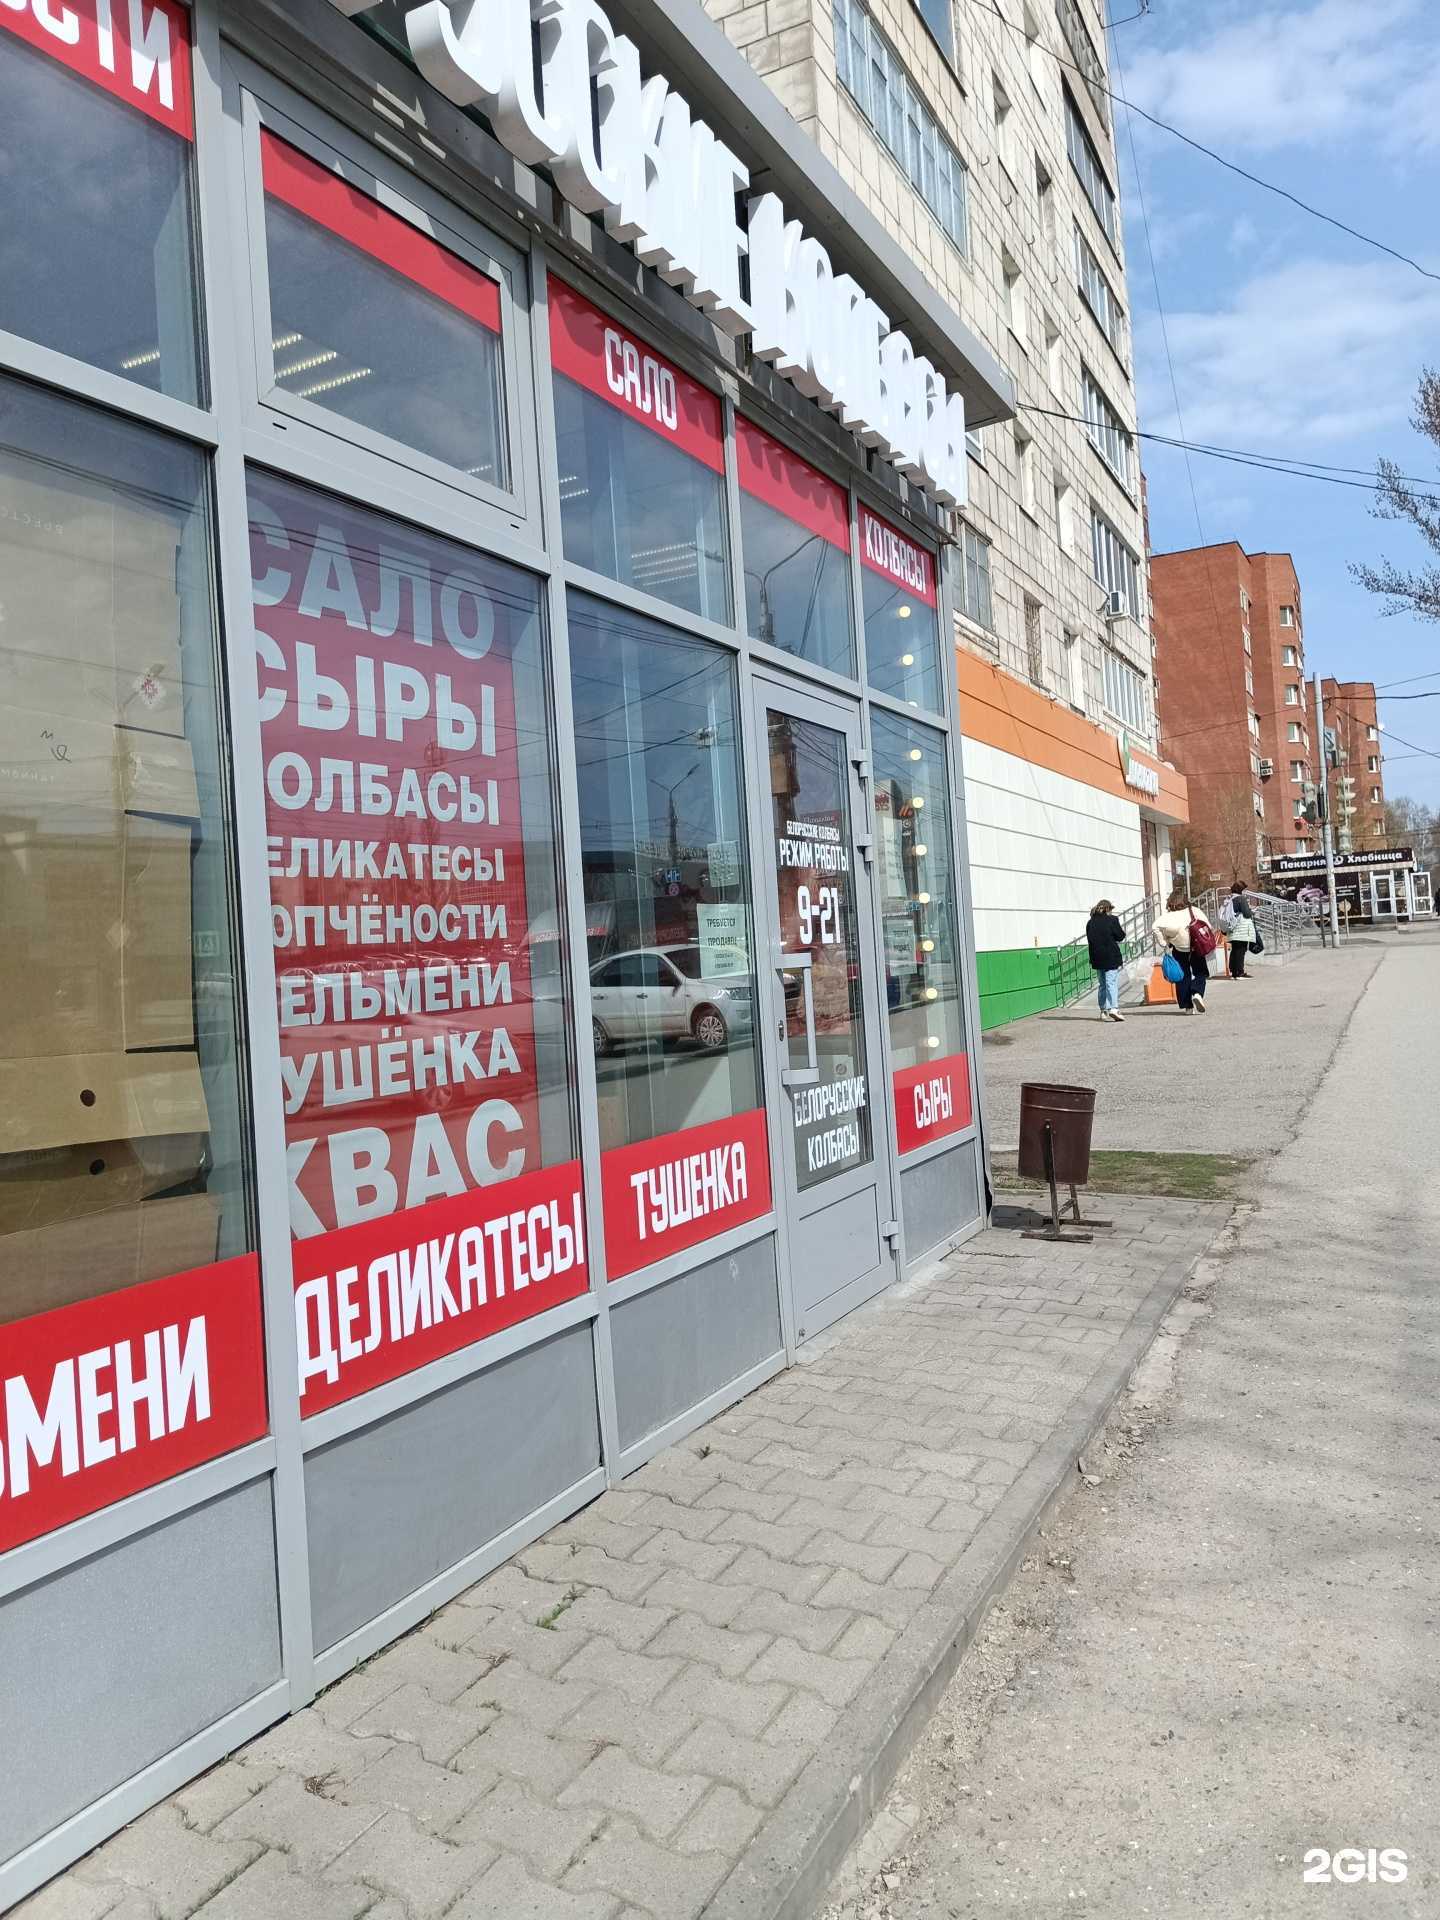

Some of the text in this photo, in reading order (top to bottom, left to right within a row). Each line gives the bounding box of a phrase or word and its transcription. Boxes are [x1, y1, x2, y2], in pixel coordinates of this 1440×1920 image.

[605, 327, 678, 431] САЛО
[249, 497, 495, 660] САЛО
[864, 513, 927, 595] КОЛБАСЫ
[267, 752, 500, 826] ОЛБАСЫ
[267, 836, 505, 882] ЕЛИКАТЕСЫ
[780, 838, 849, 871] РЕЖИМ РАБОТЫ
[1280, 851, 1403, 870] Пекарня Хлебница
[272, 894, 507, 948] ОПЧЁНОСТИ
[797, 885, 841, 944] 9-21
[280, 962, 513, 1027] ЕЛЬМЕНИ
[794, 1075, 866, 1128] БЕЛОРУССКИЕ
[914, 1075, 953, 1129] СЫРЫ
[808, 1121, 860, 1172] КОЛБАСЫ
[630, 1141, 748, 1241] ТУШЕНКА
[294, 1193, 585, 1396] ДЕЛИКАТЕСЫ
[0, 1314, 211, 1499] МЕНИ
